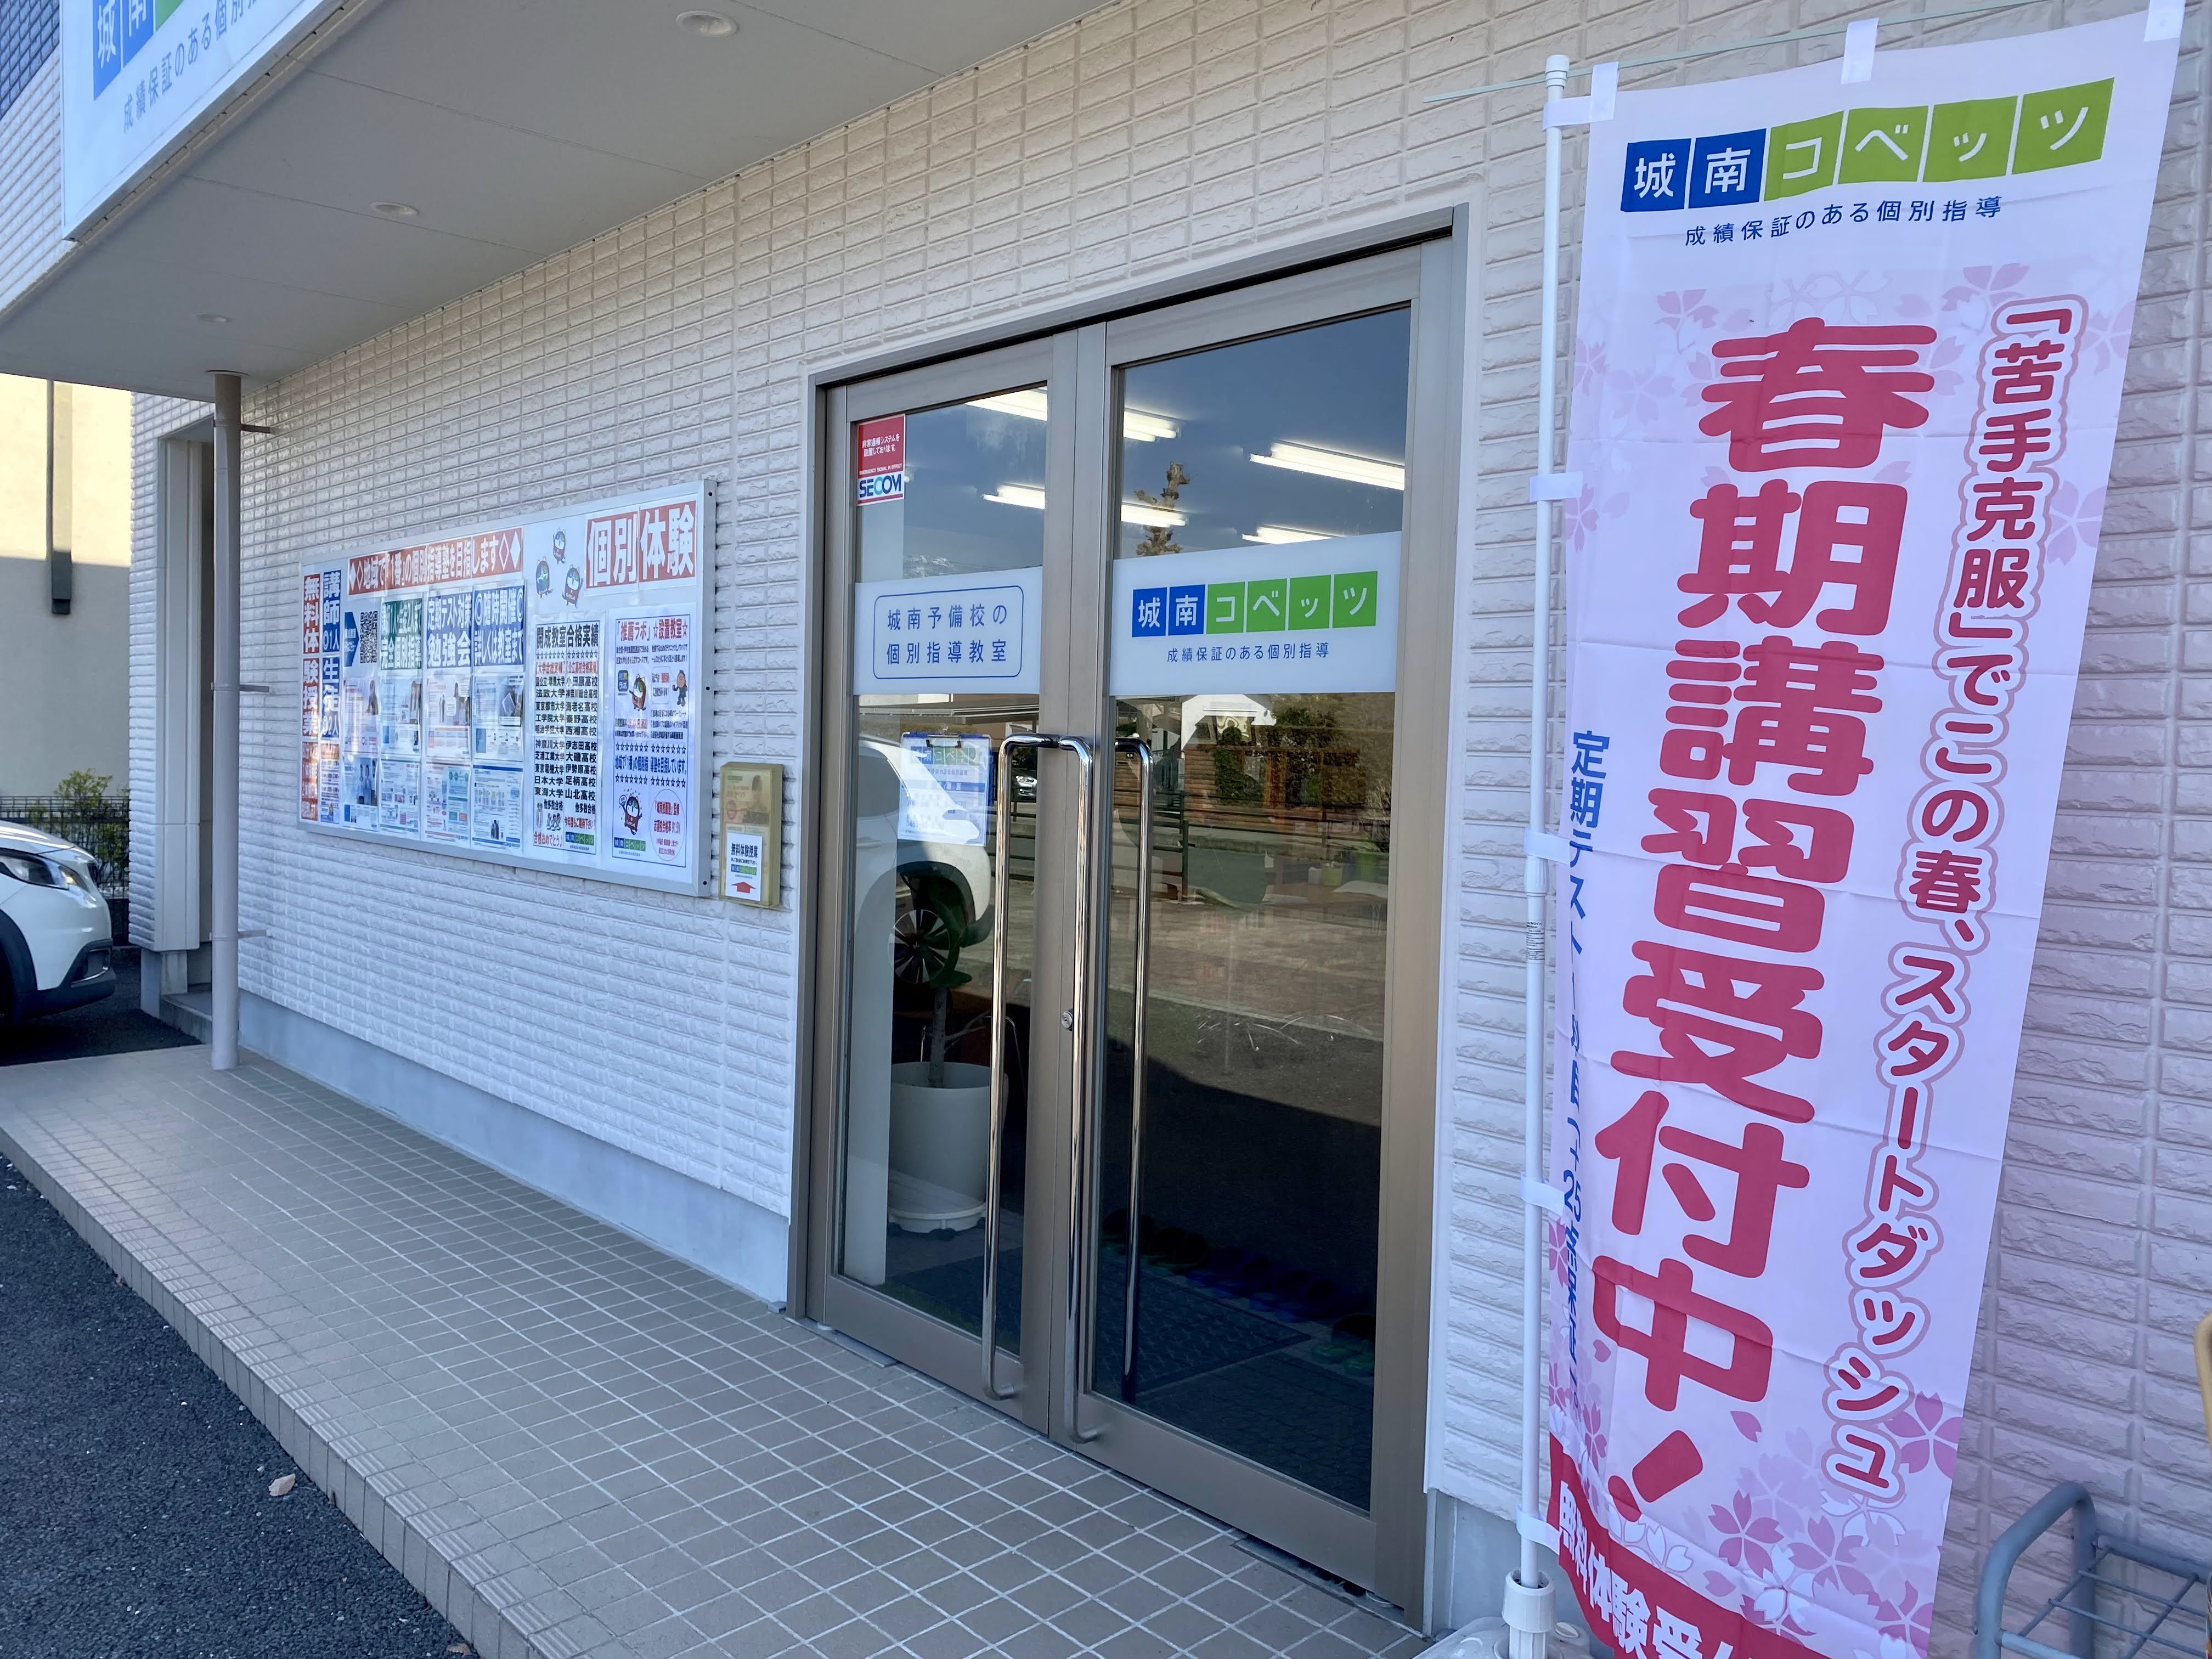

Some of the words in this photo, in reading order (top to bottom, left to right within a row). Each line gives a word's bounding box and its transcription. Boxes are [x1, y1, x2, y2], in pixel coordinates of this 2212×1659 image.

[123, 0, 256, 134] 成績保証のある個別
[1635, 105, 2089, 199] 城南コベッツ
[1685, 196, 2004, 246] 成績保証のある個別指導
[860, 473, 901, 498] SECOM
[588, 504, 695, 586] 個別体験
[427, 594, 471, 630] 定期テスト対策
[1138, 586, 1367, 628] 城南コベッツ
[887, 603, 1007, 630] 城南予備校の
[537, 623, 599, 649] 開成教室合格実績
[427, 631, 471, 667] 勉強会
[887, 639, 1007, 665] 個別指導教室
[1167, 642, 1330, 663] 成績保証のある個別指導
[566, 676, 598, 687] 小田原高校
[535, 689, 565, 698] 法政大学
[535, 701, 565, 711] 東京都市大学
[566, 701, 597, 712] 海老名高校
[535, 714, 565, 723] 工学院大学
[565, 726, 597, 736] 西湘高校
[535, 740, 565, 749] 神奈川大学
[566, 741, 597, 751] 伊志田高校
[535, 751, 565, 761] 芝浦工業大学
[566, 752, 597, 763] 大磯高校
[535, 763, 564, 775] 東京電機大学
[565, 764, 596, 775] 伊勢原高校
[534, 776, 563, 786] 日本大学
[565, 775, 596, 787] 足柄高校
[534, 787, 563, 798] 東海大学
[565, 788, 595, 801] 山北高校
